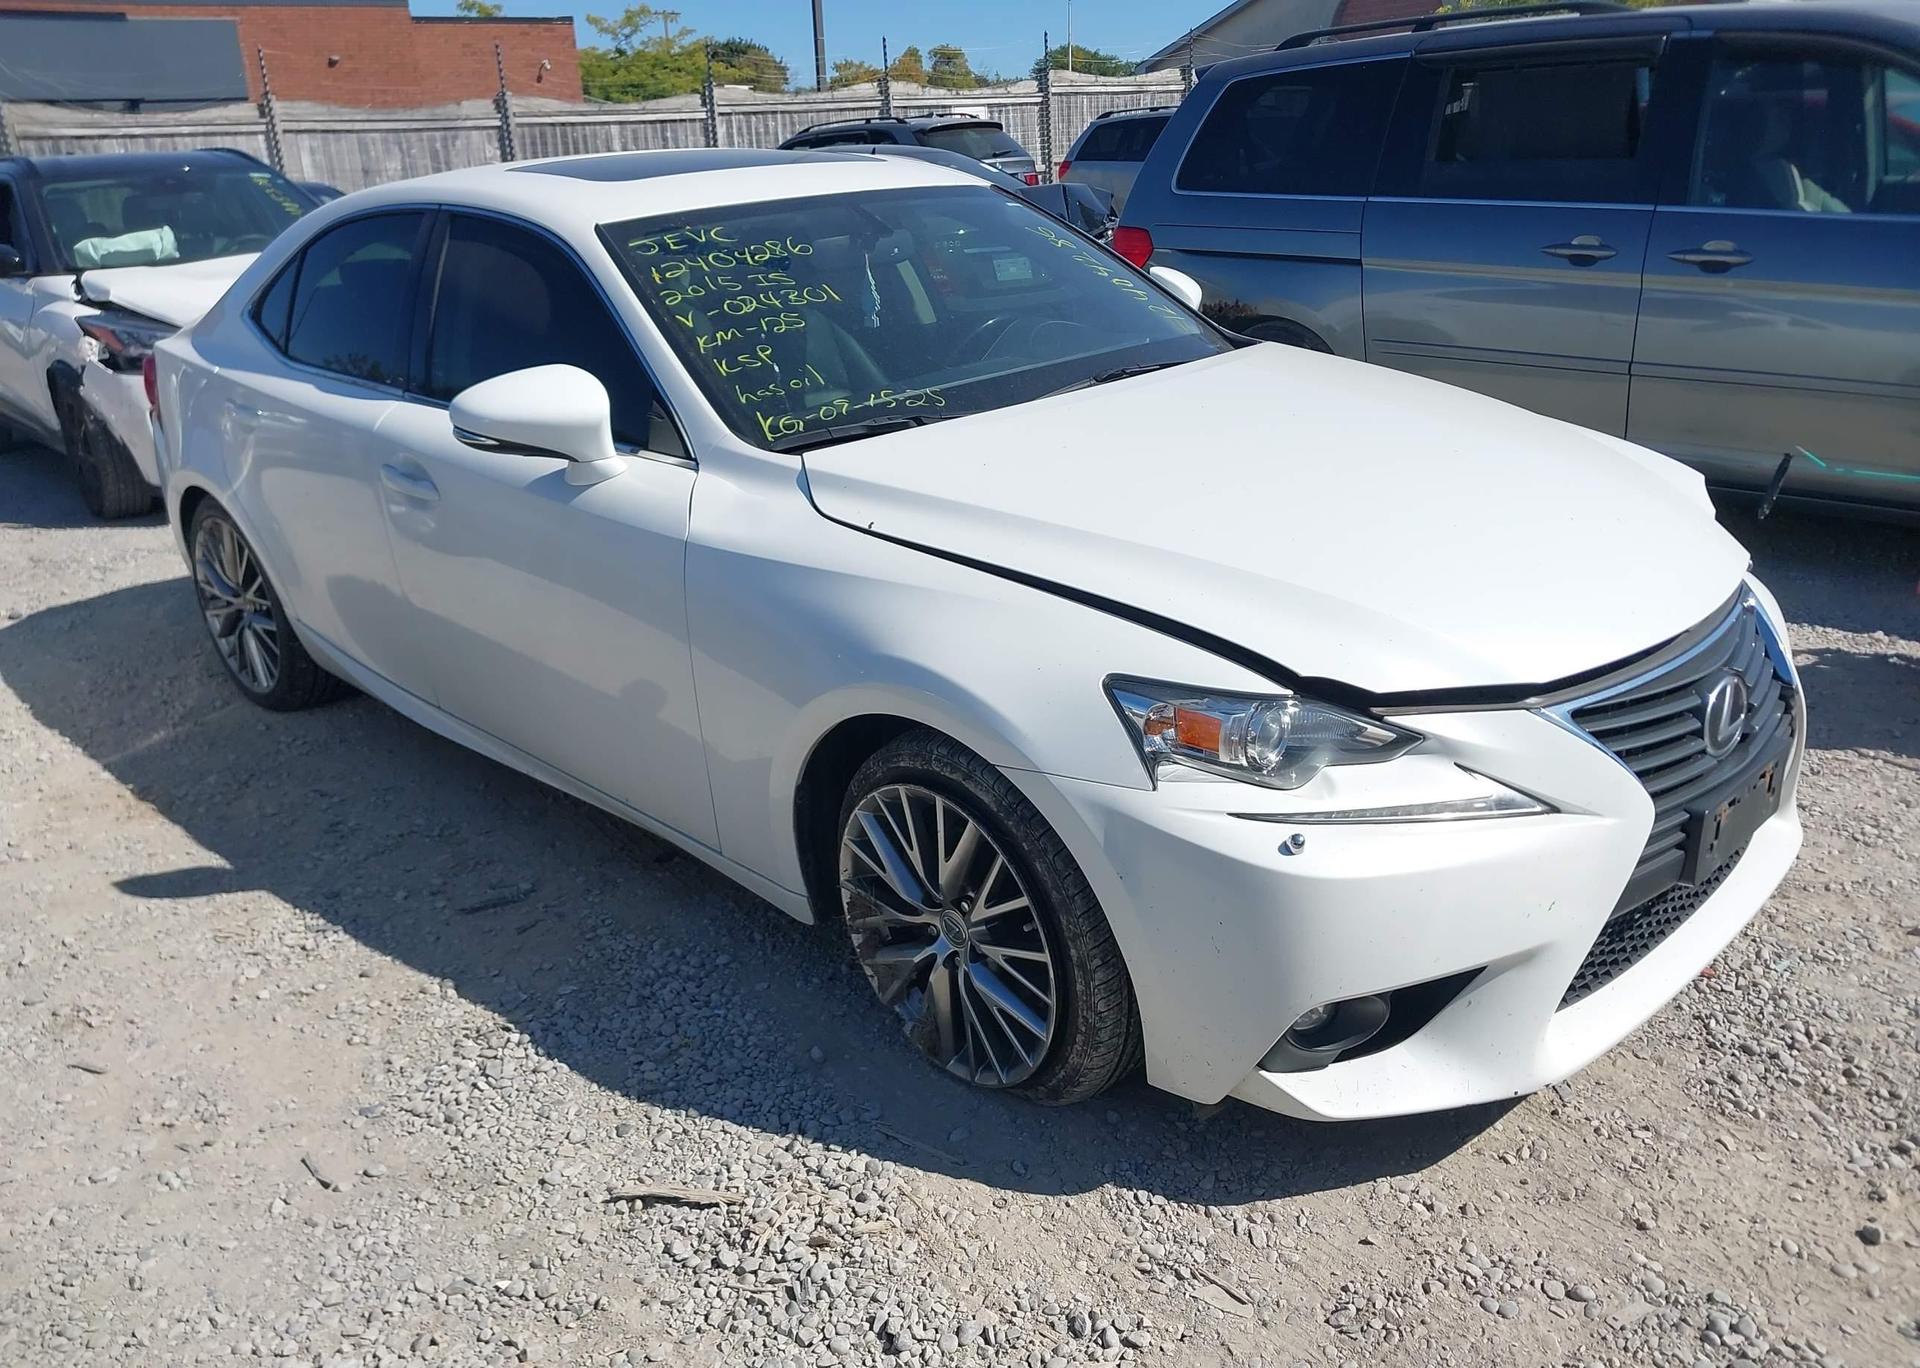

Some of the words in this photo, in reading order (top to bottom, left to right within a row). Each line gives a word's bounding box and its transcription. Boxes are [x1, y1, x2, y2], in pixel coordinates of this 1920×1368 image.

[628, 226, 739, 255] JEVC
[651, 236, 813, 284] 12404286
[659, 275, 742, 306] 2015
[748, 272, 796, 286] IS
[713, 344, 774, 377] KSP
[735, 384, 785, 405] has
[789, 363, 825, 389] oil
